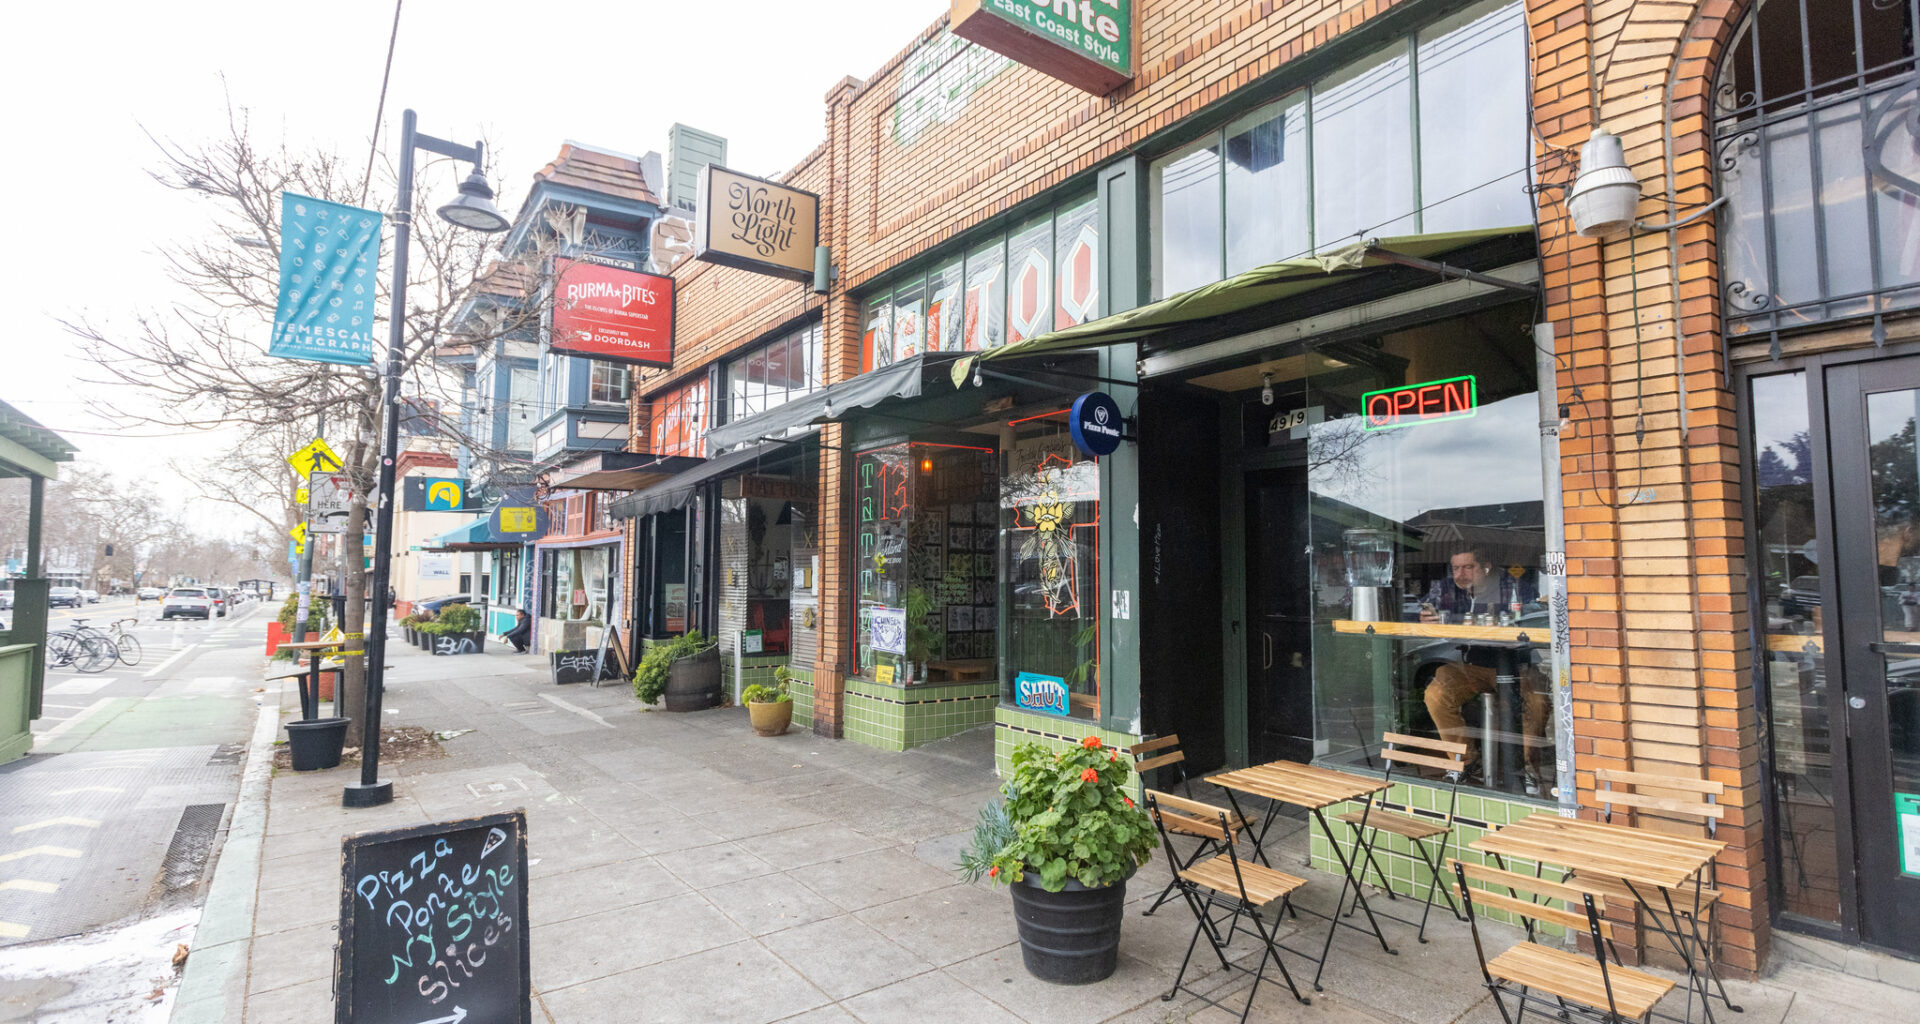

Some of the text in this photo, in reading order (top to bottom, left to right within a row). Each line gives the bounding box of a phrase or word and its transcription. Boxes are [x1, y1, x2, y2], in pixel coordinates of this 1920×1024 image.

[1035, 10, 1080, 45] Coast
[1083, 34, 1120, 63] Style
[728, 182, 797, 226] North
[731, 211, 797, 257] Light
[567, 282, 656, 311] BURMA BITES
[864, 223, 1099, 374] TATTOO
[274, 332, 371, 352] TELEGRAPH
[275, 321, 371, 342] TEMESCAL
[594, 334, 650, 350] DOORDASH
[1270, 411, 1305, 432] 4919
[1367, 380, 1470, 426] OPEN
[1083, 420, 1101, 433] Pizza
[317, 501, 342, 509] HERE
[1020, 680, 1065, 711] SHUT
[357, 838, 453, 910] Pizza
[386, 863, 480, 936] Ponte
[384, 865, 514, 985] NY Style
[418, 911, 513, 1004] Slices
